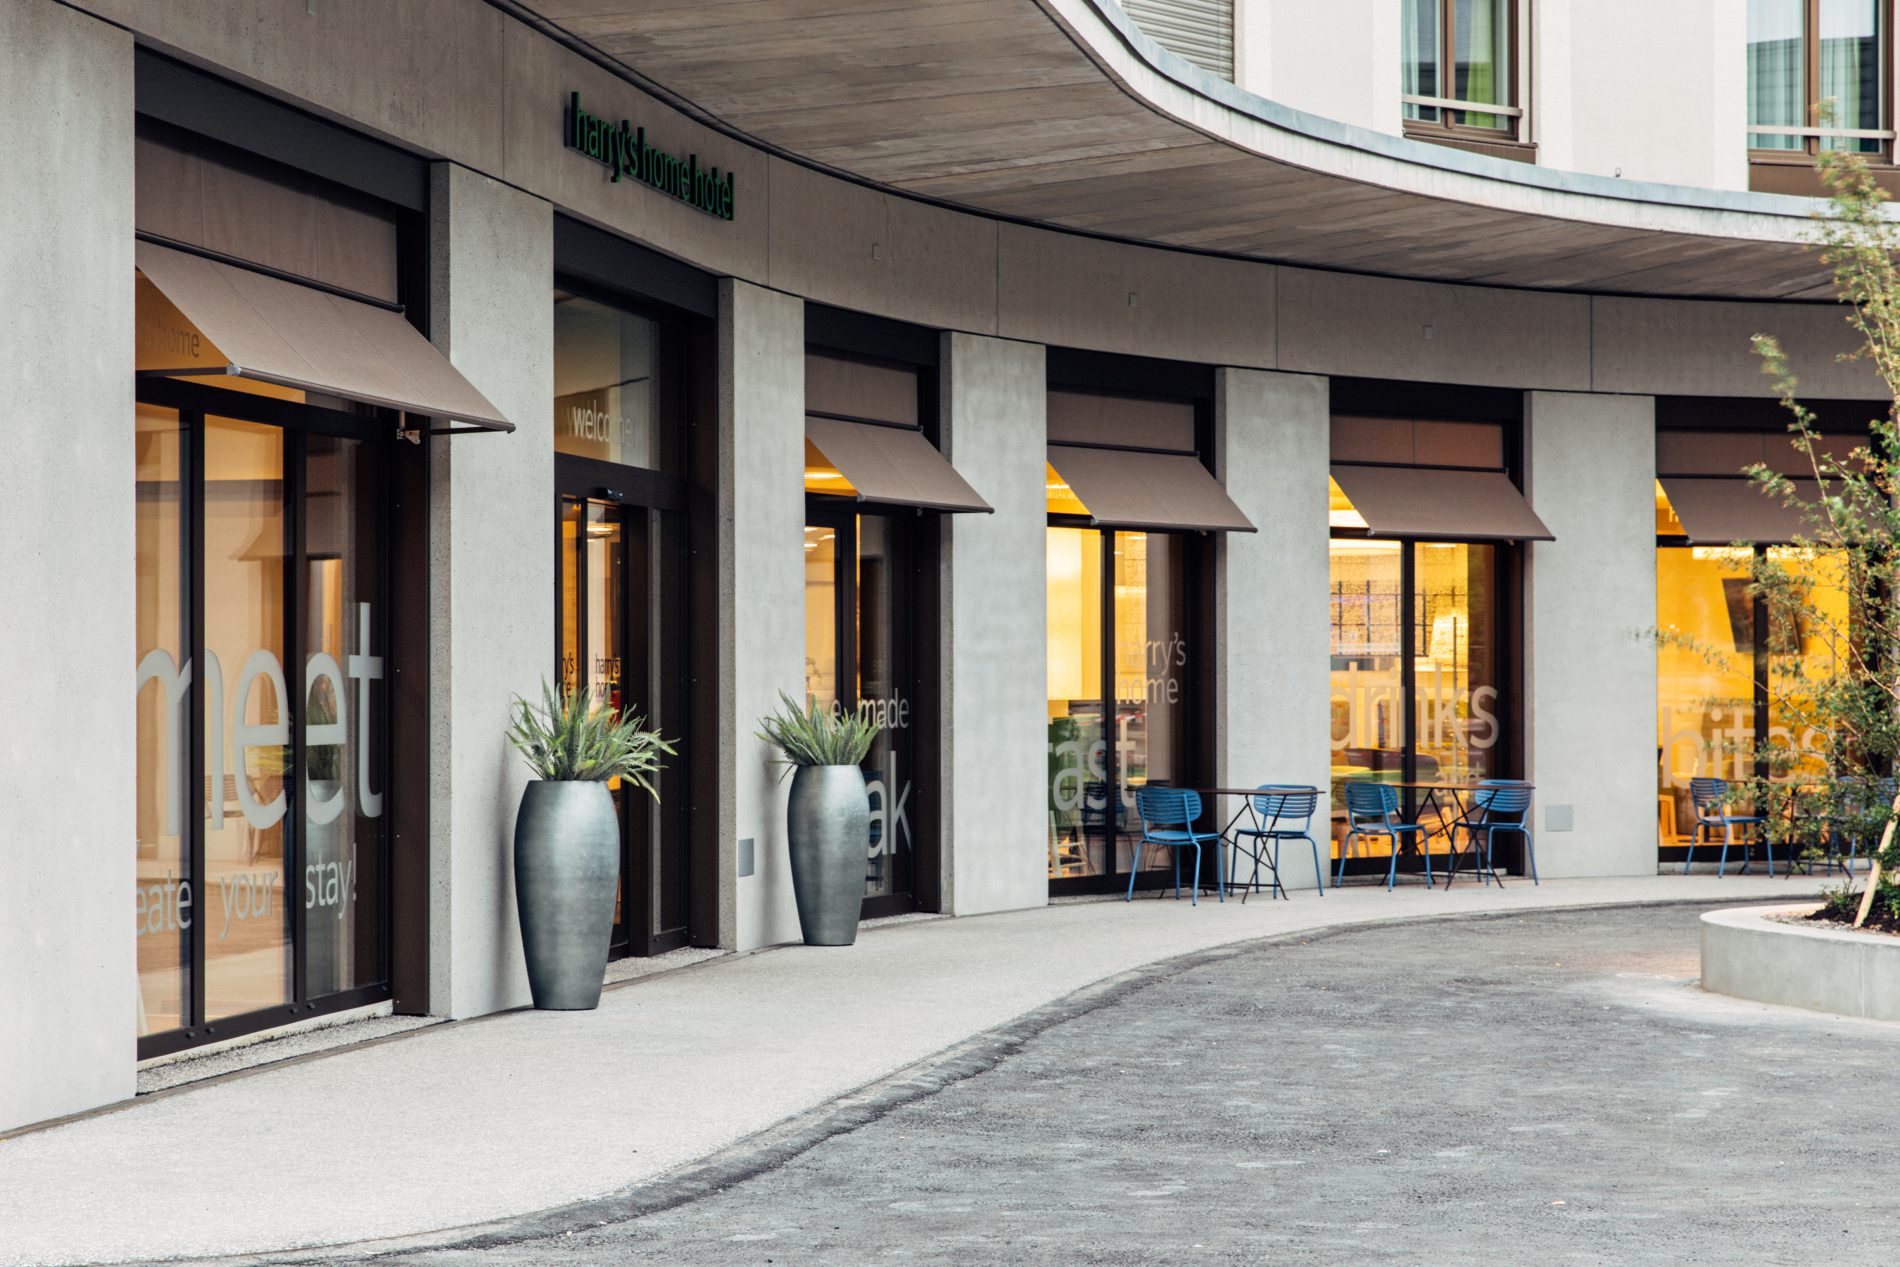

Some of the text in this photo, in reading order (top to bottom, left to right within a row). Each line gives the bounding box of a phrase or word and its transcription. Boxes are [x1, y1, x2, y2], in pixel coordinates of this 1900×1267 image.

[565, 92, 734, 221] harry's home hotel
[860, 688, 910, 729] made
[1118, 671, 1179, 705] home
[1048, 718, 1137, 811] ast
[136, 843, 357, 940] eate your stay!
